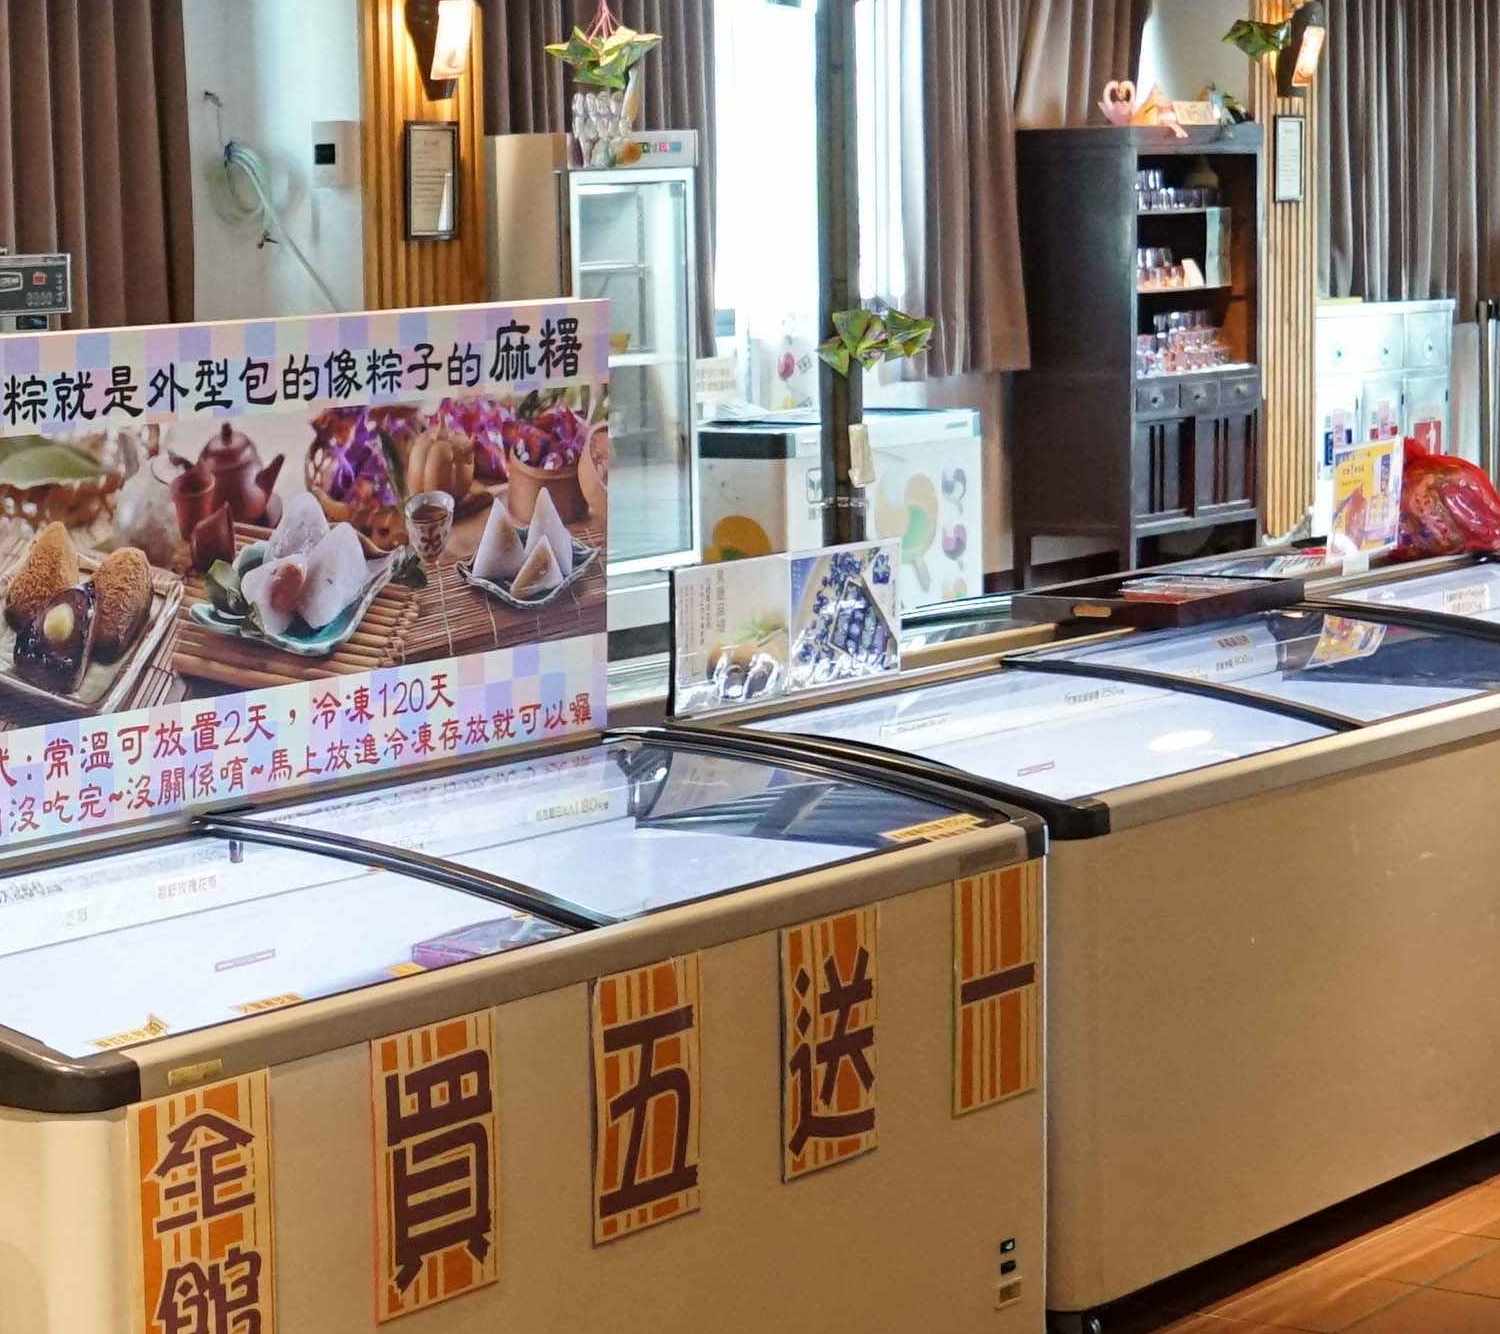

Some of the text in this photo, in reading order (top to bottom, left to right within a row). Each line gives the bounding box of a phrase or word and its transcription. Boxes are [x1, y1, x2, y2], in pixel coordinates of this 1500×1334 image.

[382, 1046, 495, 1296] 買
[599, 1001, 700, 1219] 五
[785, 945, 878, 1157] 送
